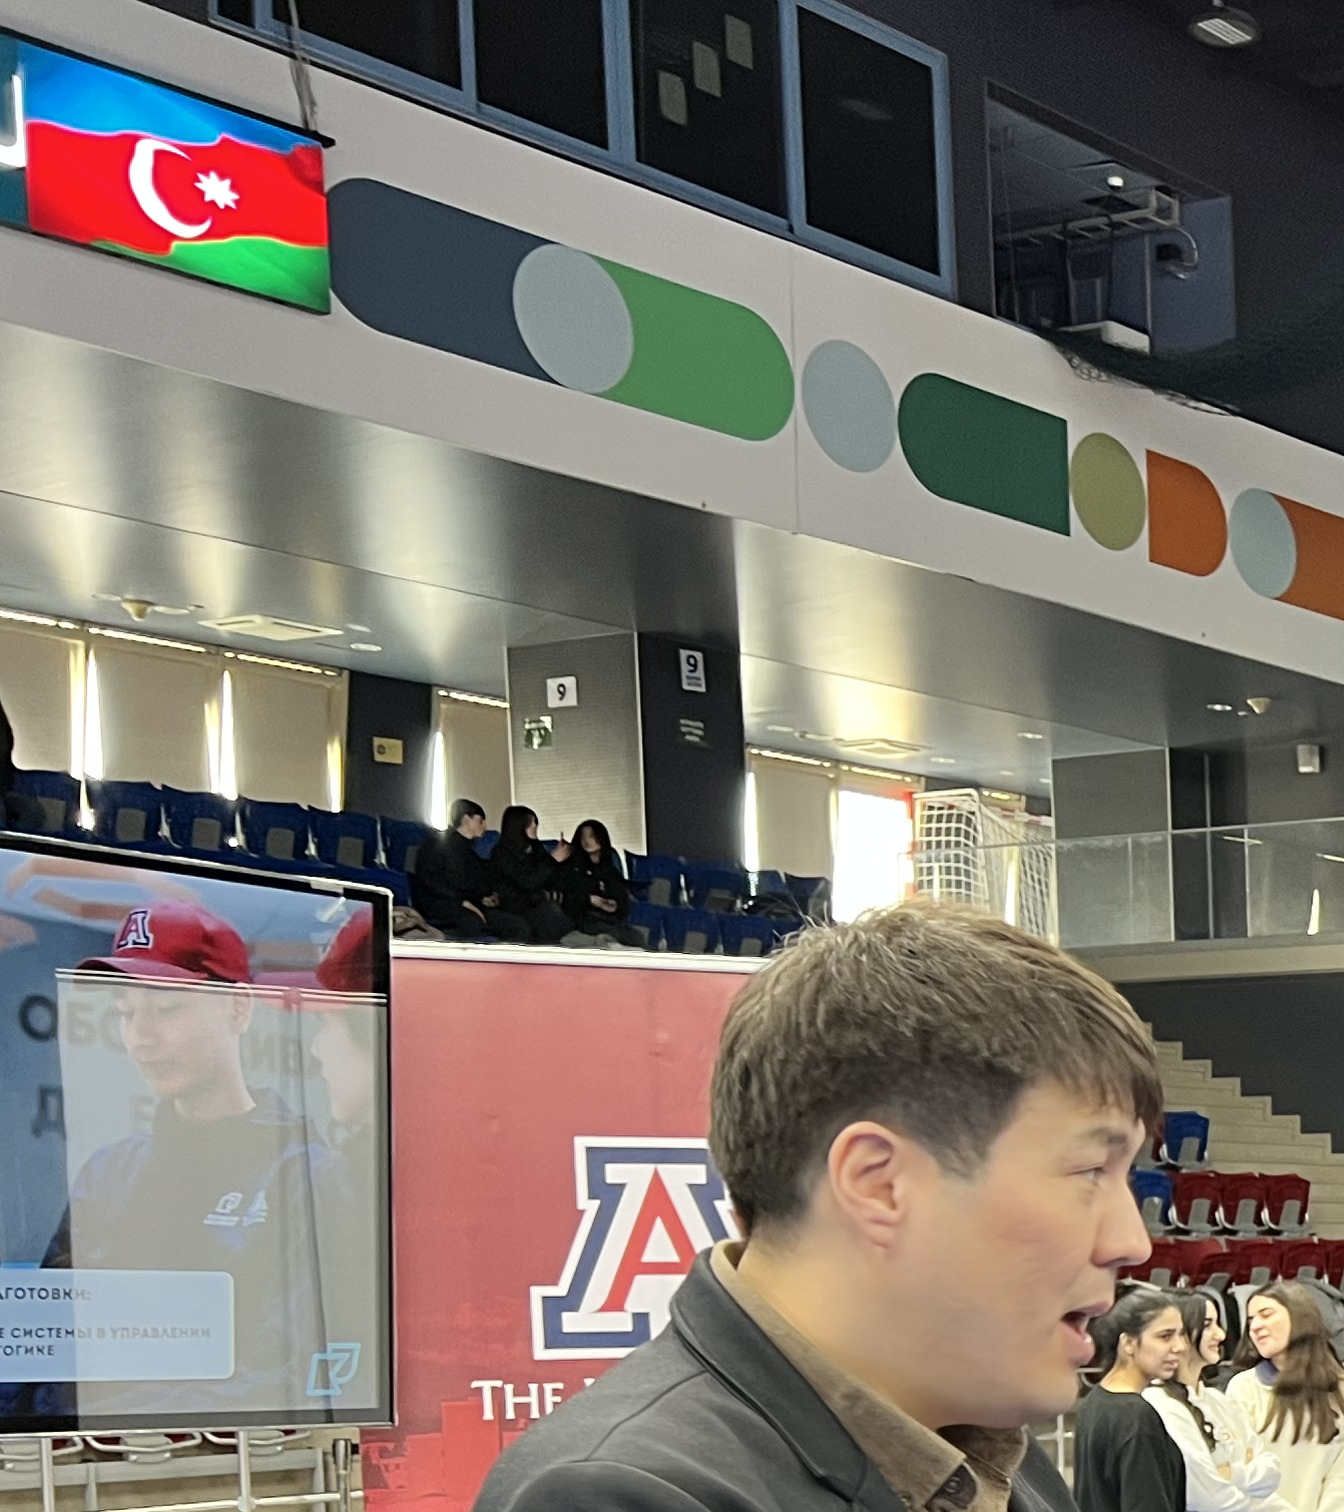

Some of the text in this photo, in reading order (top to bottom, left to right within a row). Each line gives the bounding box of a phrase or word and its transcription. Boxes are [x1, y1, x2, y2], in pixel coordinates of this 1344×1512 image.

[686, 654, 699, 673] 9
[556, 683, 567, 701] 9
[116, 908, 154, 950] A
[11, 1327, 93, 1339] СИСТЕМЫ
[470, 1378, 565, 1421] THE
